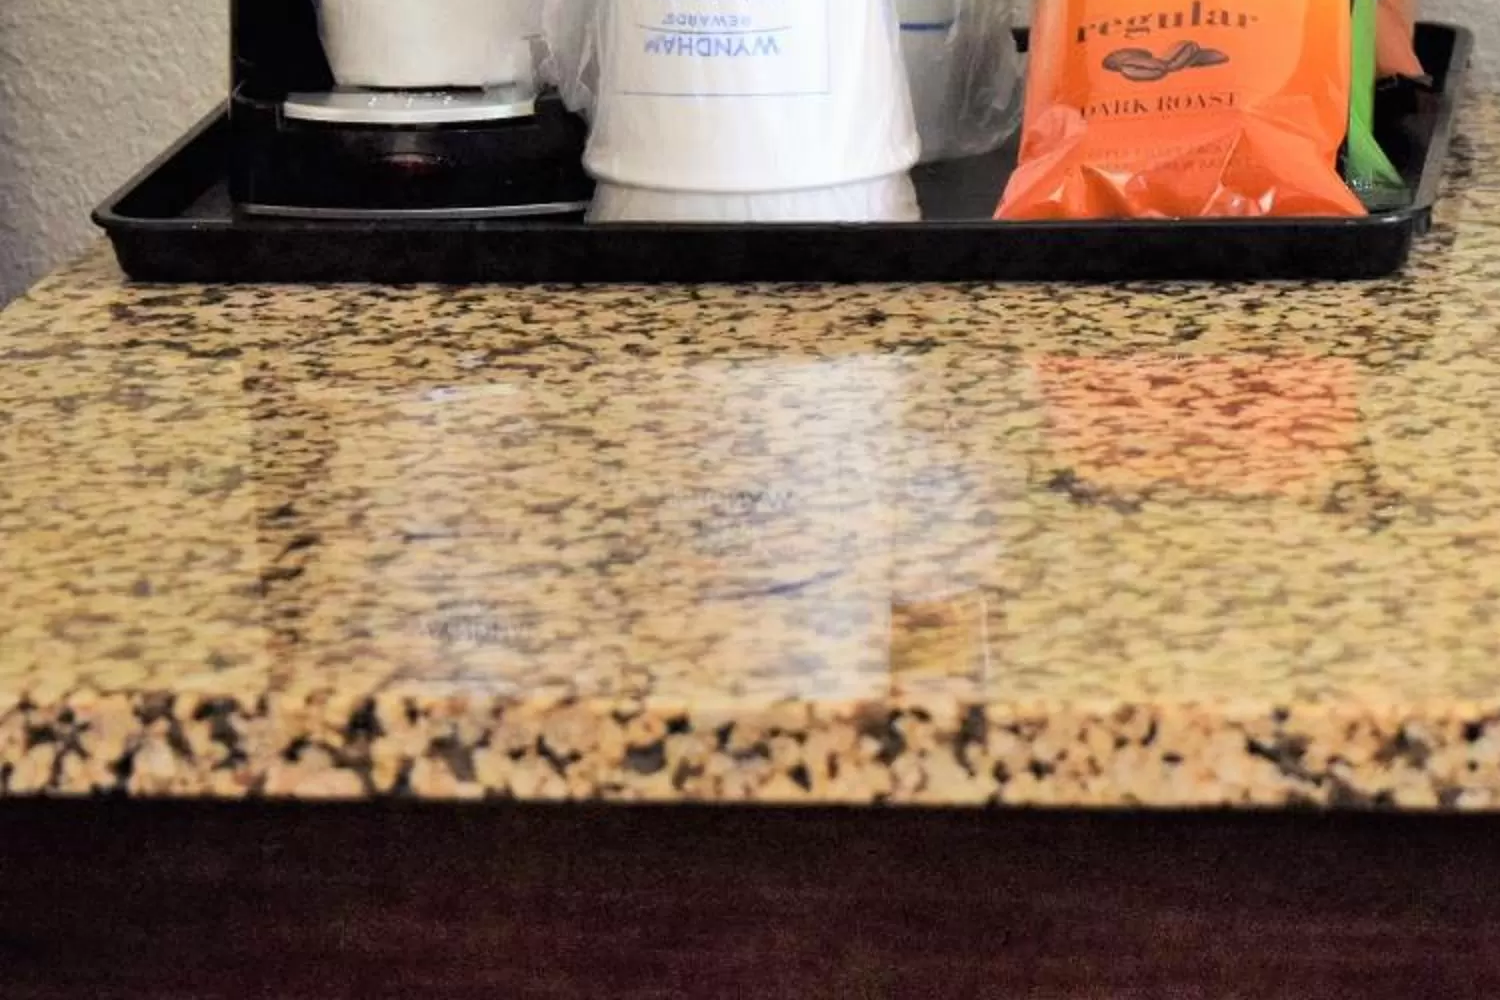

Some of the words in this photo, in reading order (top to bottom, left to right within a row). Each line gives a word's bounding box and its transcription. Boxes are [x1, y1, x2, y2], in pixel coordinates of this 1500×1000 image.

[1076, 0, 1259, 43] regular
[643, 35, 782, 57] WYNDHAM
[1080, 99, 1149, 119] DARK
[1157, 92, 1237, 112] ROAST
